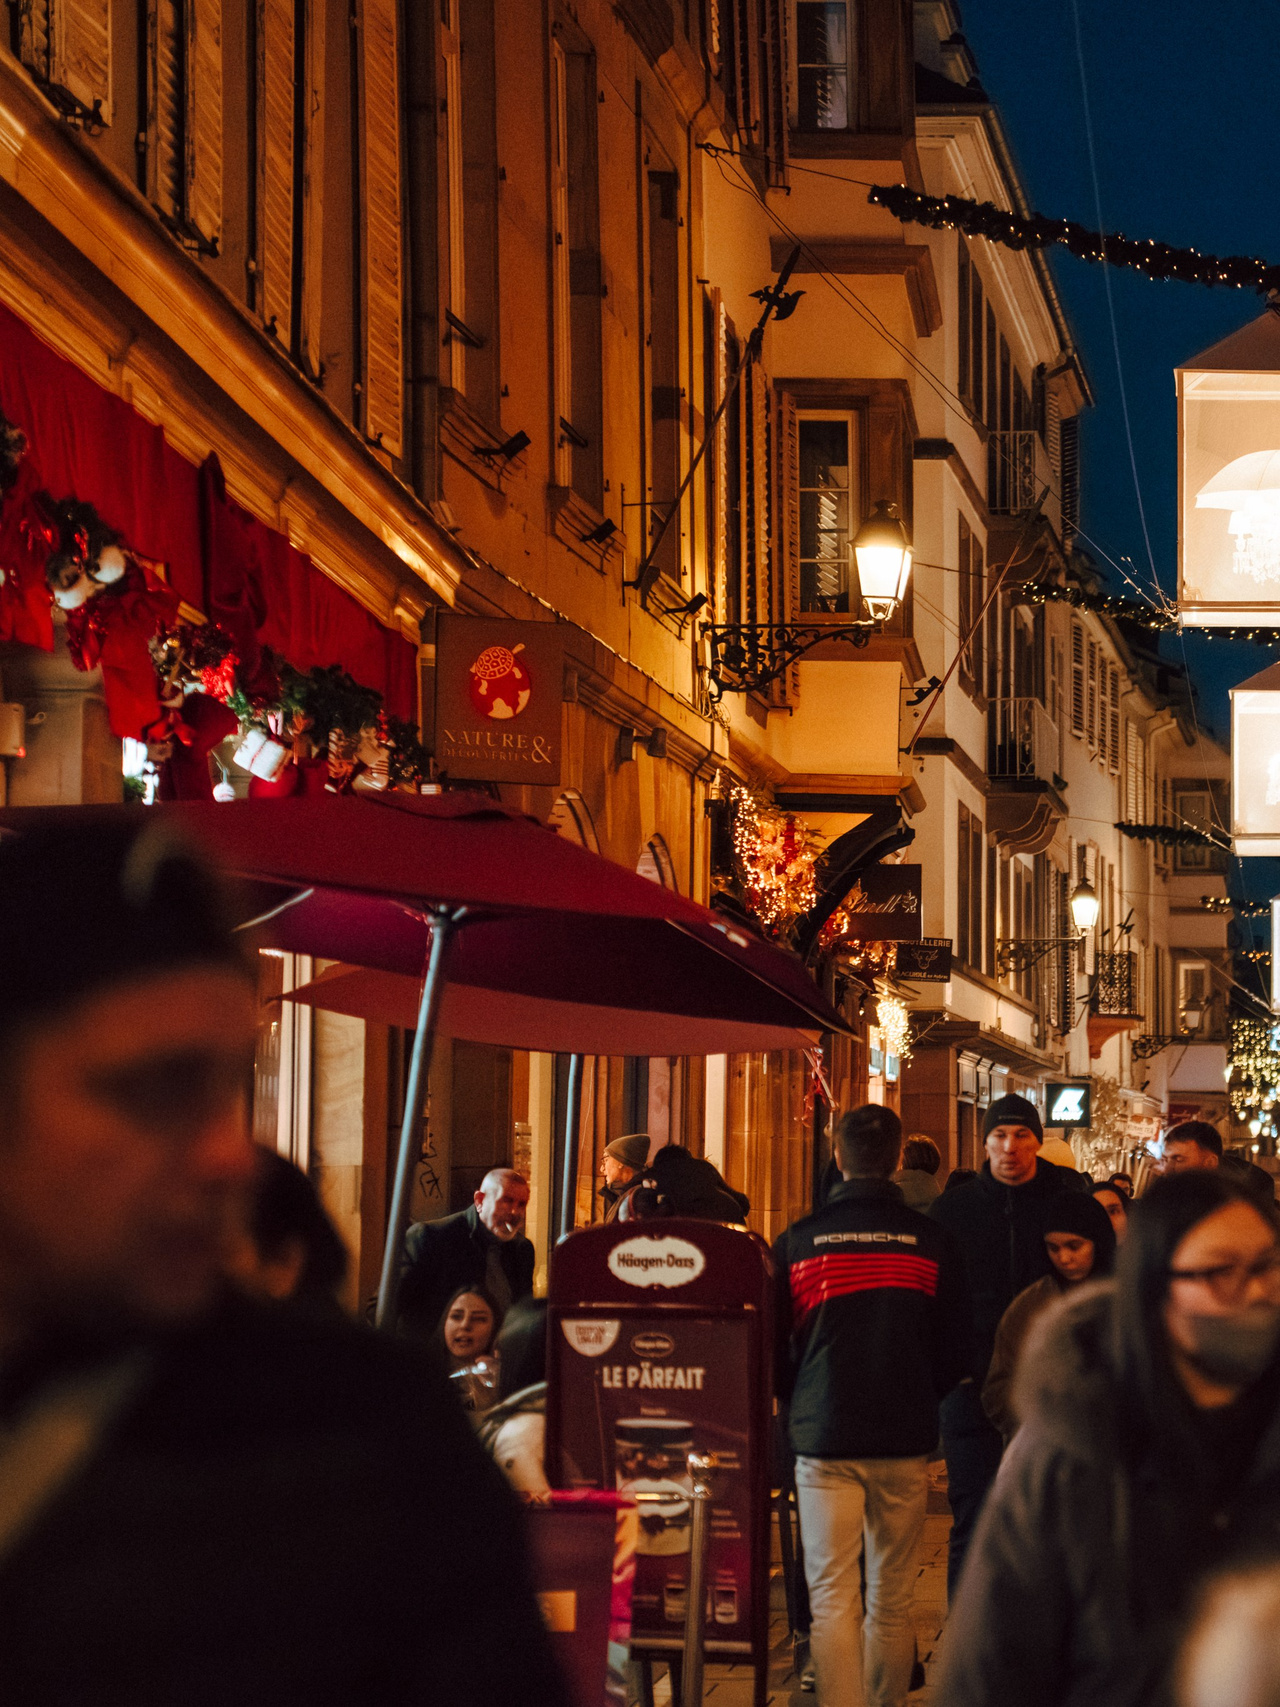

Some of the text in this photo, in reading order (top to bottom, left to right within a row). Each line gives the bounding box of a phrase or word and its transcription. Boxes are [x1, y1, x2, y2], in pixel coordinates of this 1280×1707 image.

[443, 729, 552, 764] NATURE &
[848, 892, 902, 913] Lindt
[813, 1232, 917, 1246] PORSCHE
[617, 1253, 695, 1271] Häagen-Dazs
[602, 1361, 705, 1390] LE PÄRFAIT
